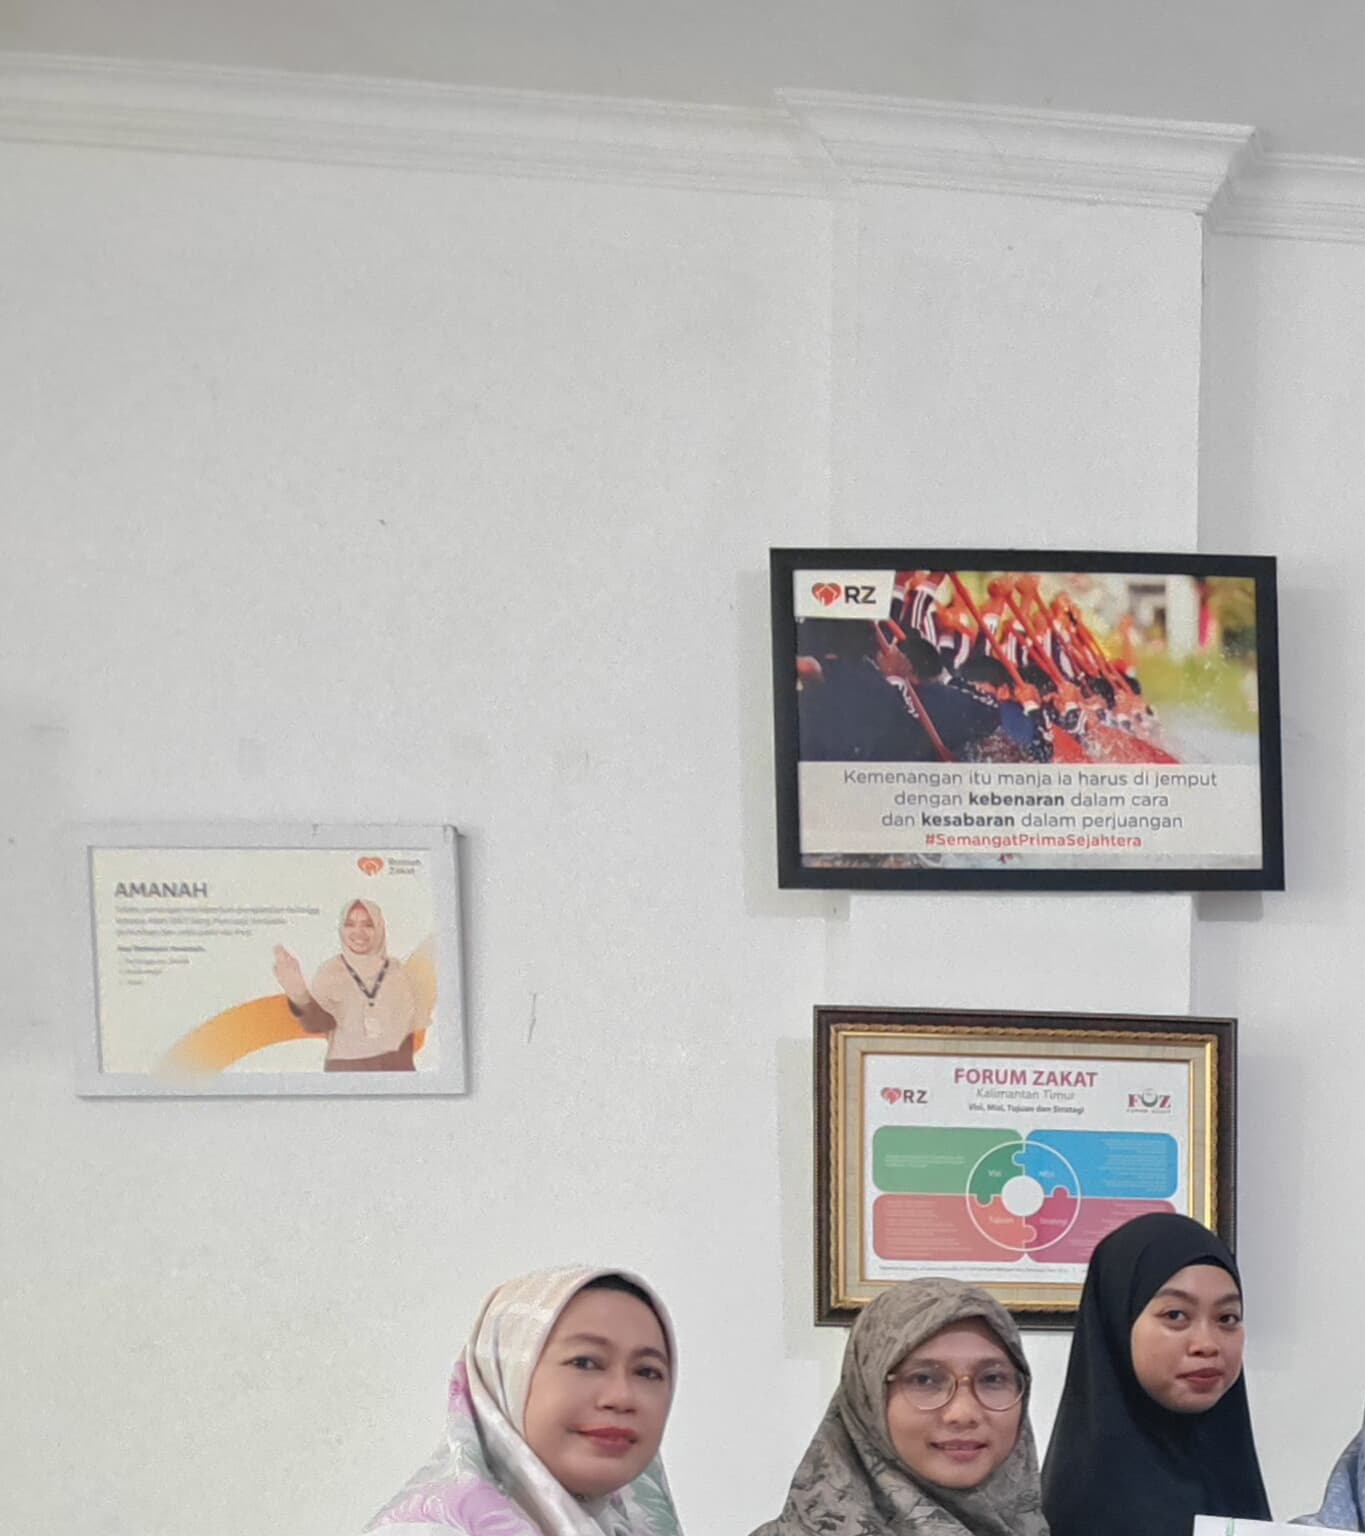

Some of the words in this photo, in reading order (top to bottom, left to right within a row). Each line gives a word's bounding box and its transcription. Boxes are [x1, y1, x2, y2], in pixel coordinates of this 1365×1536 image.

[844, 585, 877, 604] RZ
[843, 769, 963, 787] Kemenangan
[969, 770, 992, 786] itu
[997, 771, 1051, 788] manja
[1058, 771, 1073, 786] ia
[1078, 771, 1128, 786] harus
[1133, 771, 1149, 786] di
[1154, 771, 1218, 788] jemput
[893, 790, 963, 806] dengan
[968, 791, 1065, 807] kebenaran
[1070, 792, 1126, 807] dalam
[1131, 795, 1169, 807] cara
[881, 812, 916, 828] dan
[921, 812, 1015, 828] kesabaran
[1020, 812, 1076, 828] dalam
[1082, 813, 1183, 831] perjuangan
[925, 833, 1142, 849] #SemangatPrimaSejahtera
[114, 882, 208, 898] AMANAH
[954, 1068, 1028, 1085] FORUM
[1032, 1070, 1098, 1088] ZAKAT
[903, 1089, 929, 1104] RZ
[975, 1088, 1040, 1100] Kalimantan
[1043, 1088, 1076, 1101] Timur
